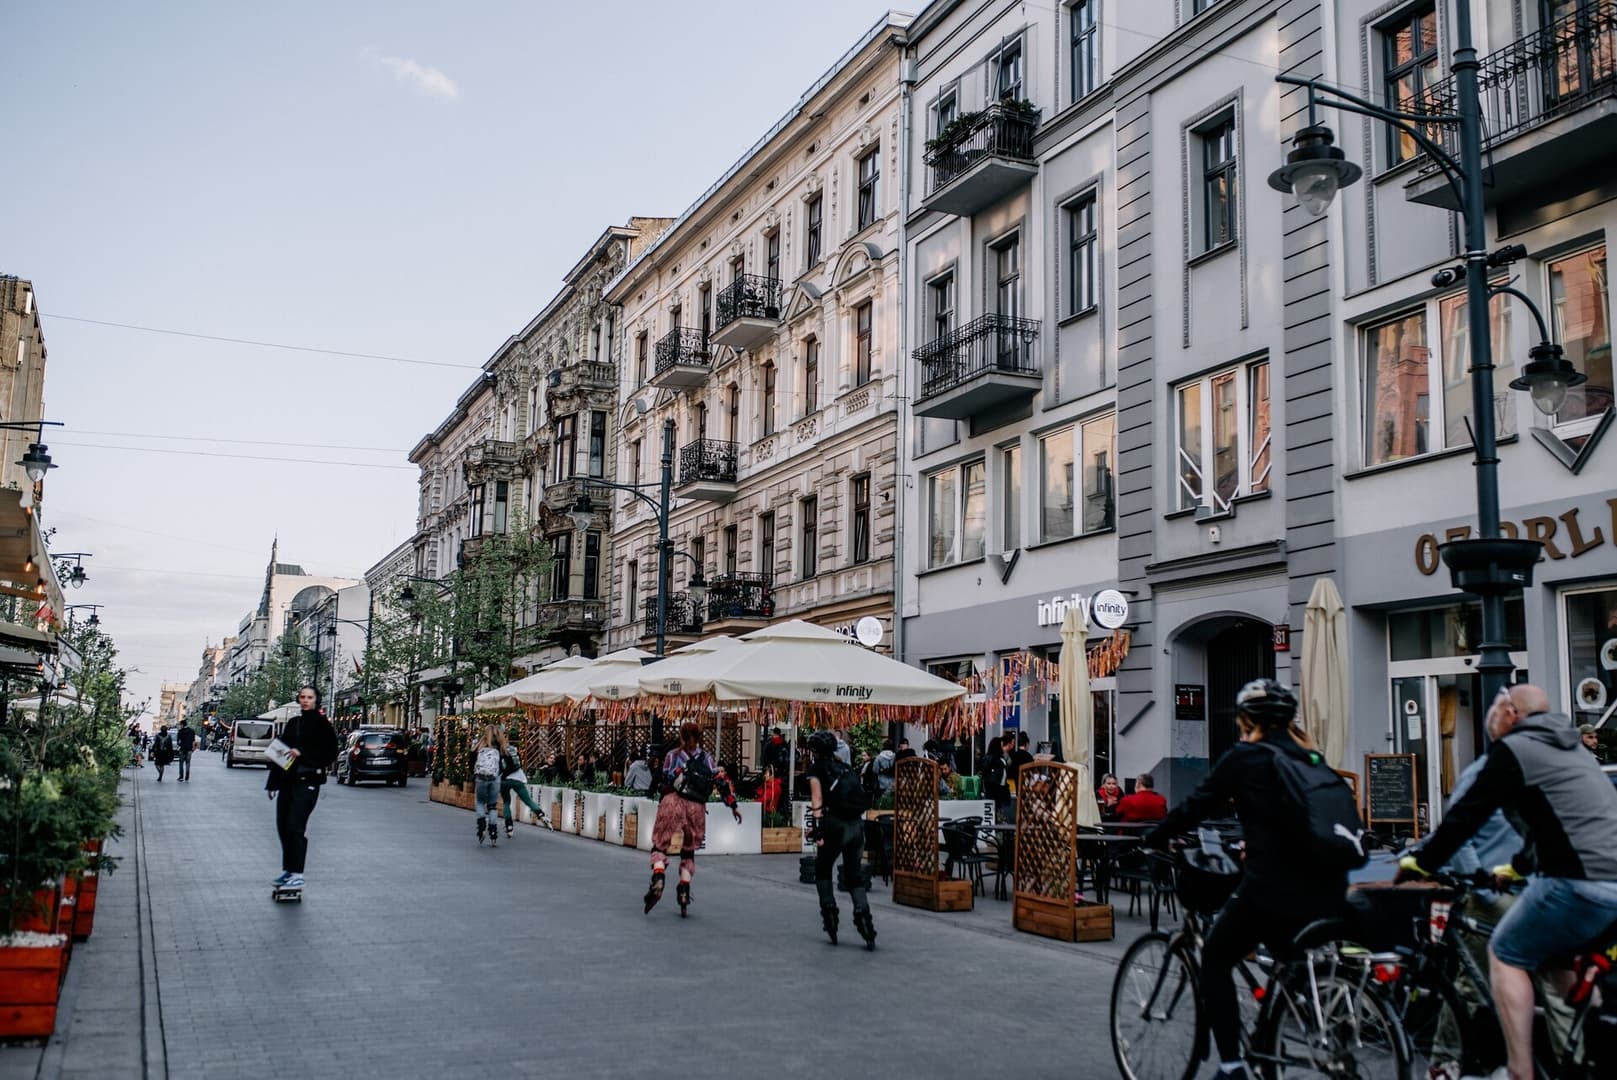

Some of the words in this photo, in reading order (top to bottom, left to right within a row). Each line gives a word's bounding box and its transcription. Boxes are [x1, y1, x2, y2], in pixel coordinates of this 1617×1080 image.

[1096, 602, 1126, 616] infinity
[1275, 631, 1286, 645] 81
[836, 685, 873, 699] infinity
